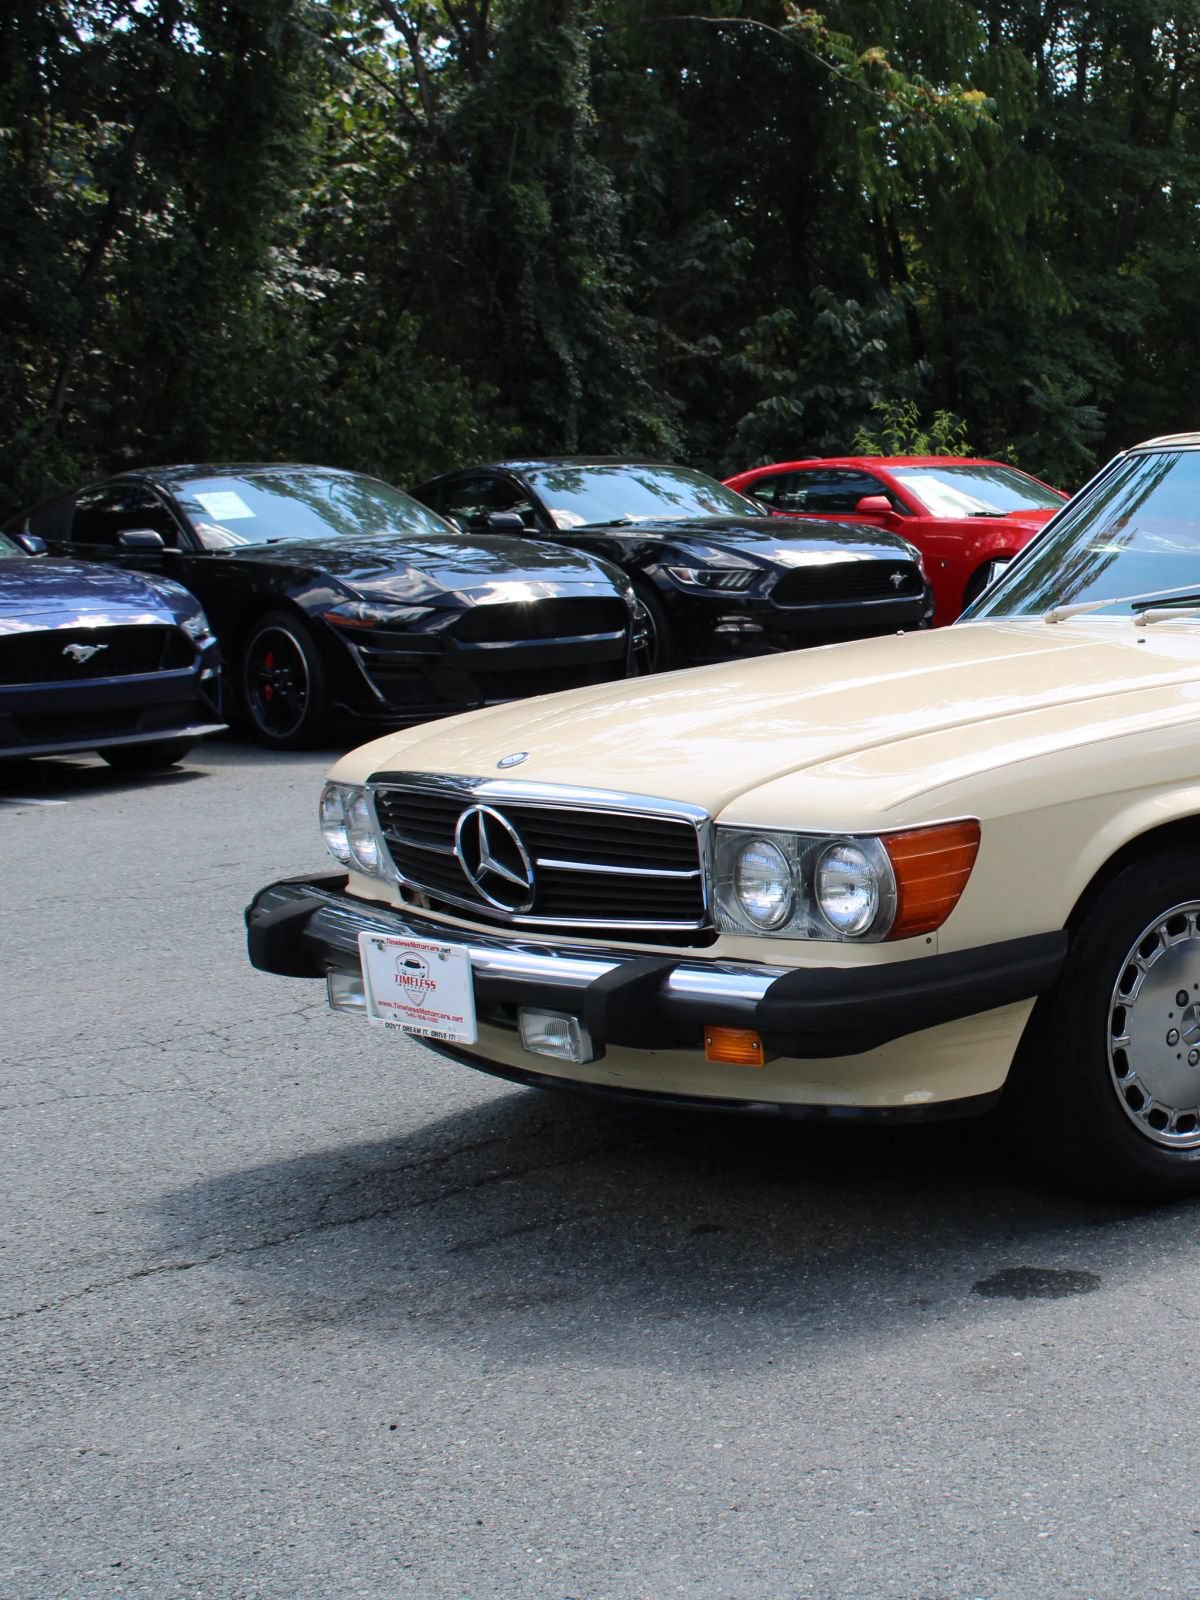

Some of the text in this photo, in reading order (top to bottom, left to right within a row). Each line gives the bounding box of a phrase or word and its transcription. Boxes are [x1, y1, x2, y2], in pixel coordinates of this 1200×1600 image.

[371, 938, 451, 954] www.TimelessMotorcars.net
[395, 974, 436, 990] TIMELESS
[378, 1000, 463, 1023] www.TimelessMotorcars.net
[385, 1022, 401, 1030] DON'T
[402, 1025, 422, 1034] DREAM
[431, 1030, 447, 1039] DRIVE
